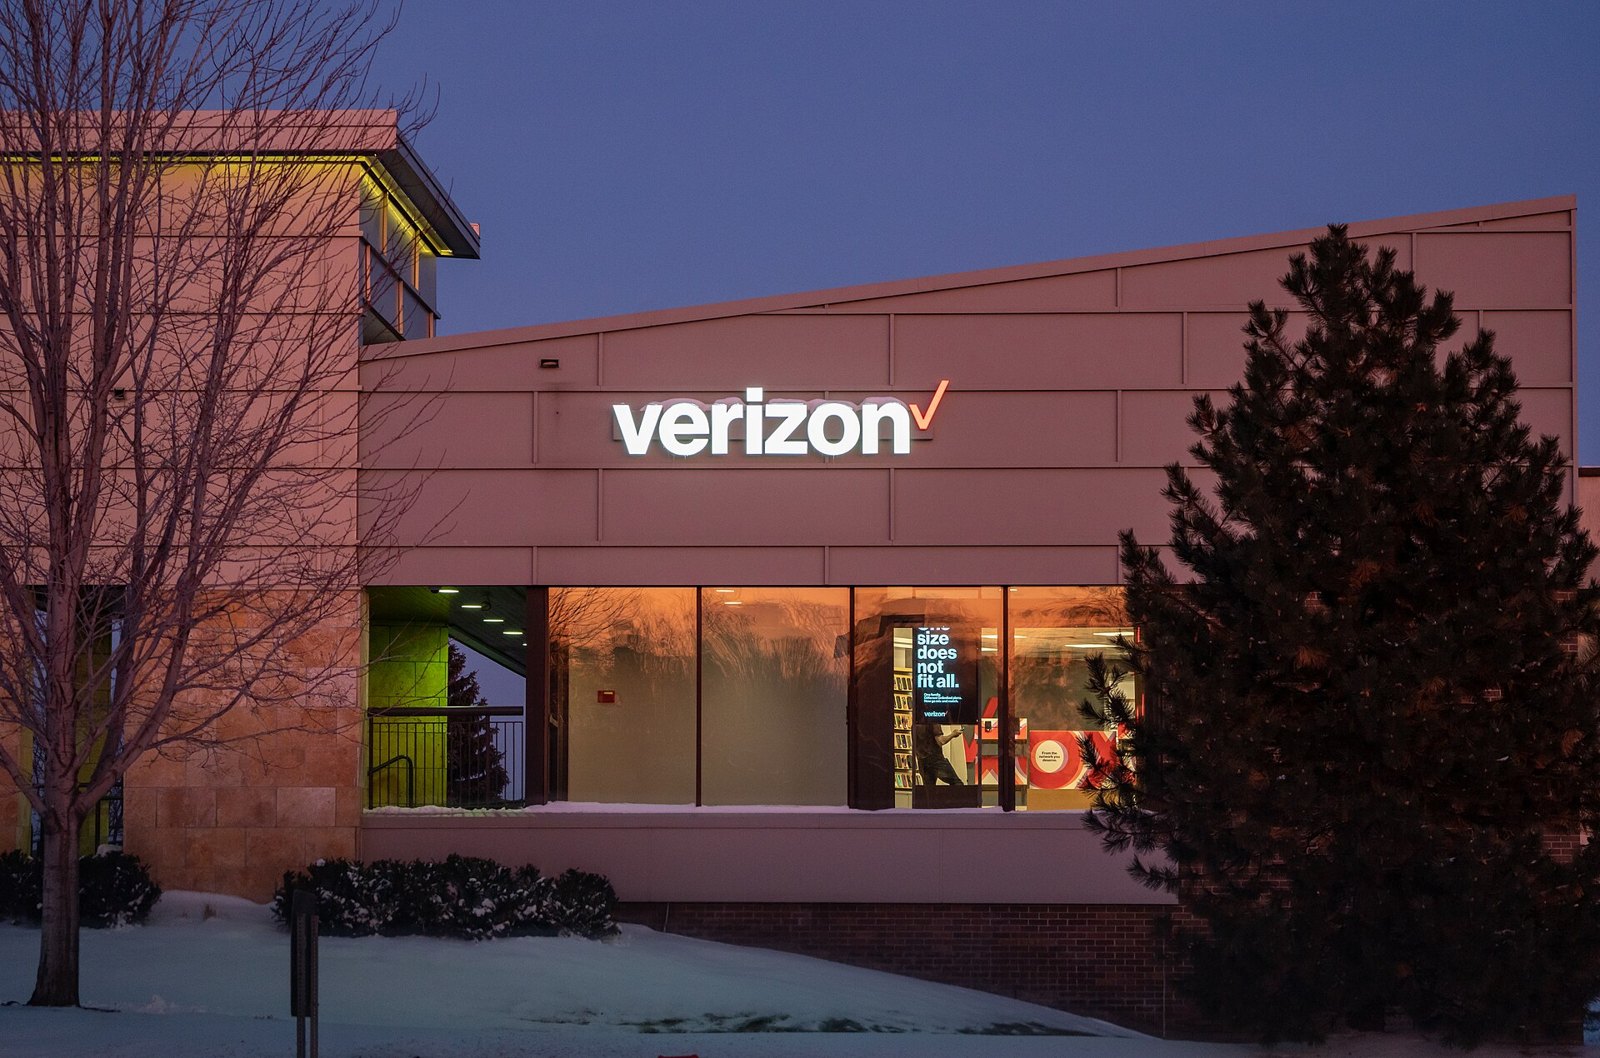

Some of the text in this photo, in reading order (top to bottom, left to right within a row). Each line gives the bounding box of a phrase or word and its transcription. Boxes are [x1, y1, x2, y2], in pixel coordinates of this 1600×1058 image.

[613, 387, 910, 456] verizon
[917, 630, 949, 645] size
[917, 645, 957, 660] does
[917, 660, 944, 674] not
[917, 673, 960, 688] fit all.
